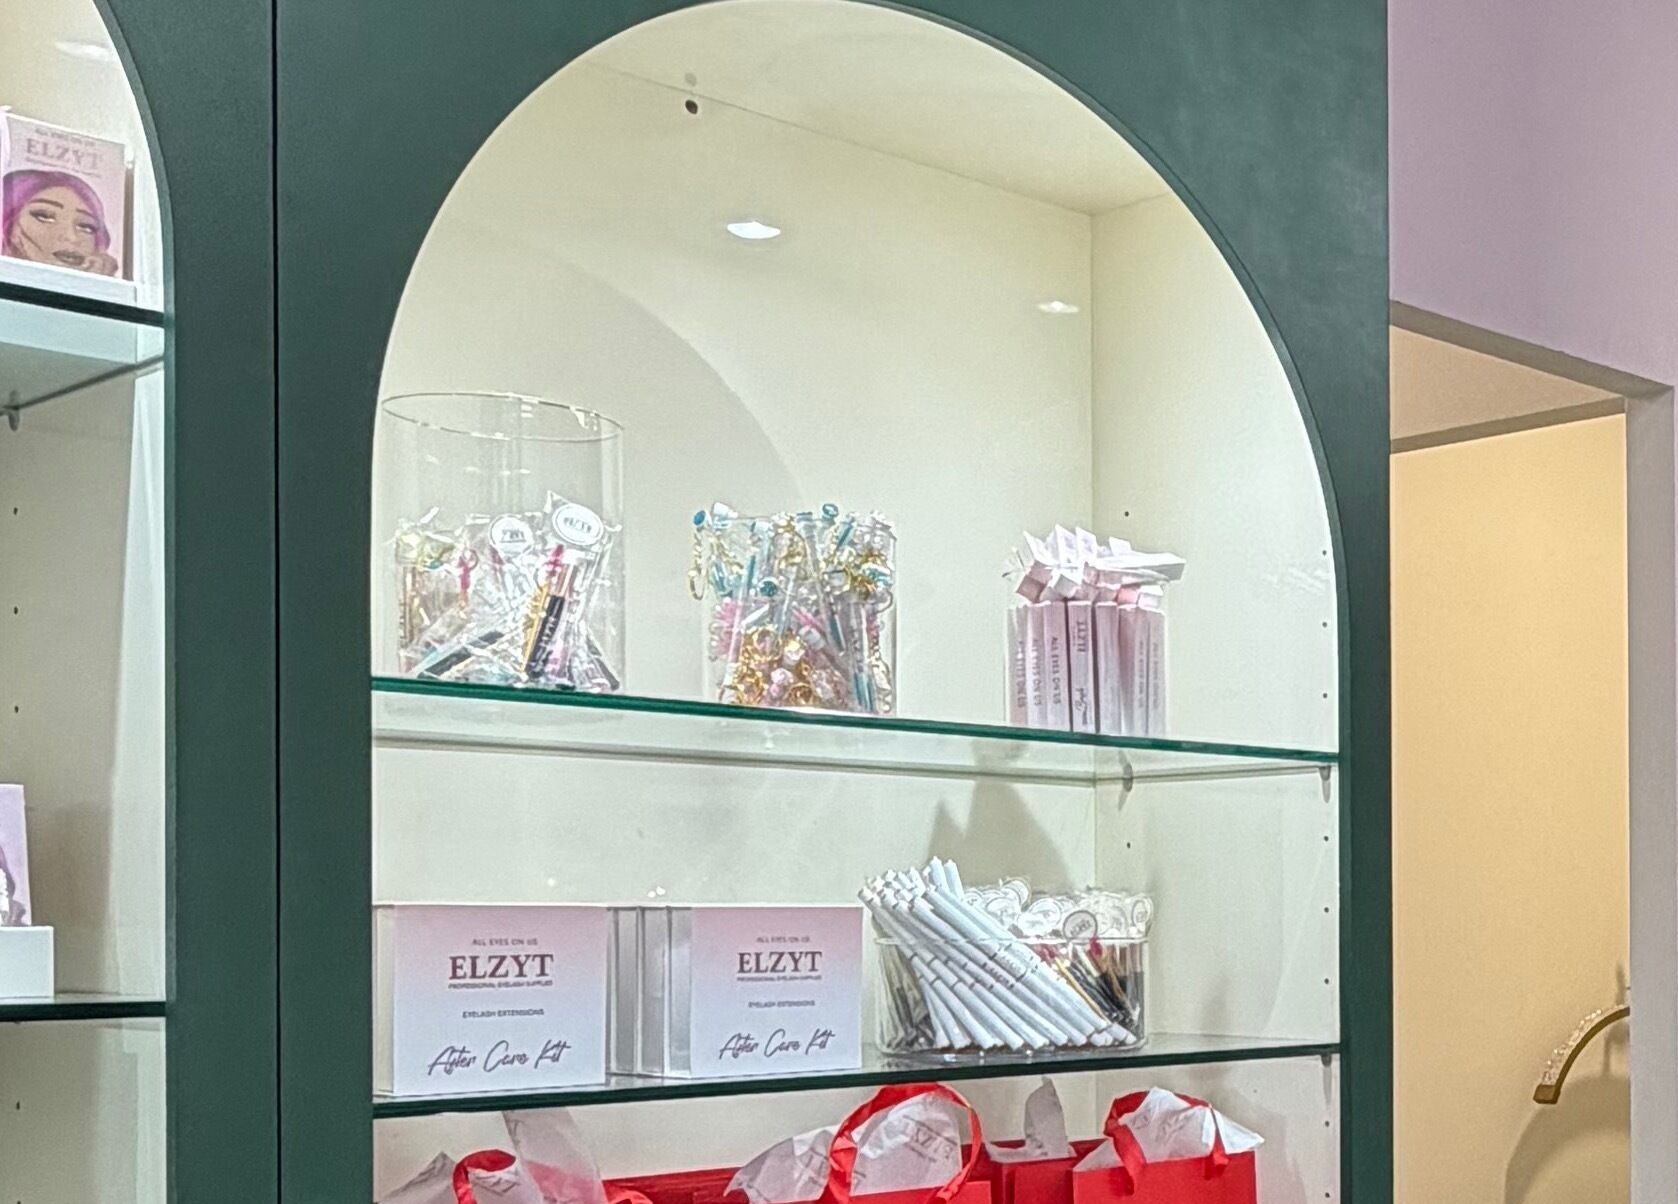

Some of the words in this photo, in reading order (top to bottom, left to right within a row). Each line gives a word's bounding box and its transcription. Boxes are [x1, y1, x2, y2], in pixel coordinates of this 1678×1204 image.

[26, 138, 103, 170] ELZYT
[448, 954, 554, 980] ELZYT
[737, 951, 822, 974] ELZYT
[427, 1045, 477, 1076] After
[483, 1040, 529, 1073] Care
[534, 1039, 571, 1069] Kit
[719, 1033, 759, 1060] After
[764, 1029, 801, 1058] Care
[805, 1028, 836, 1055] Kit
